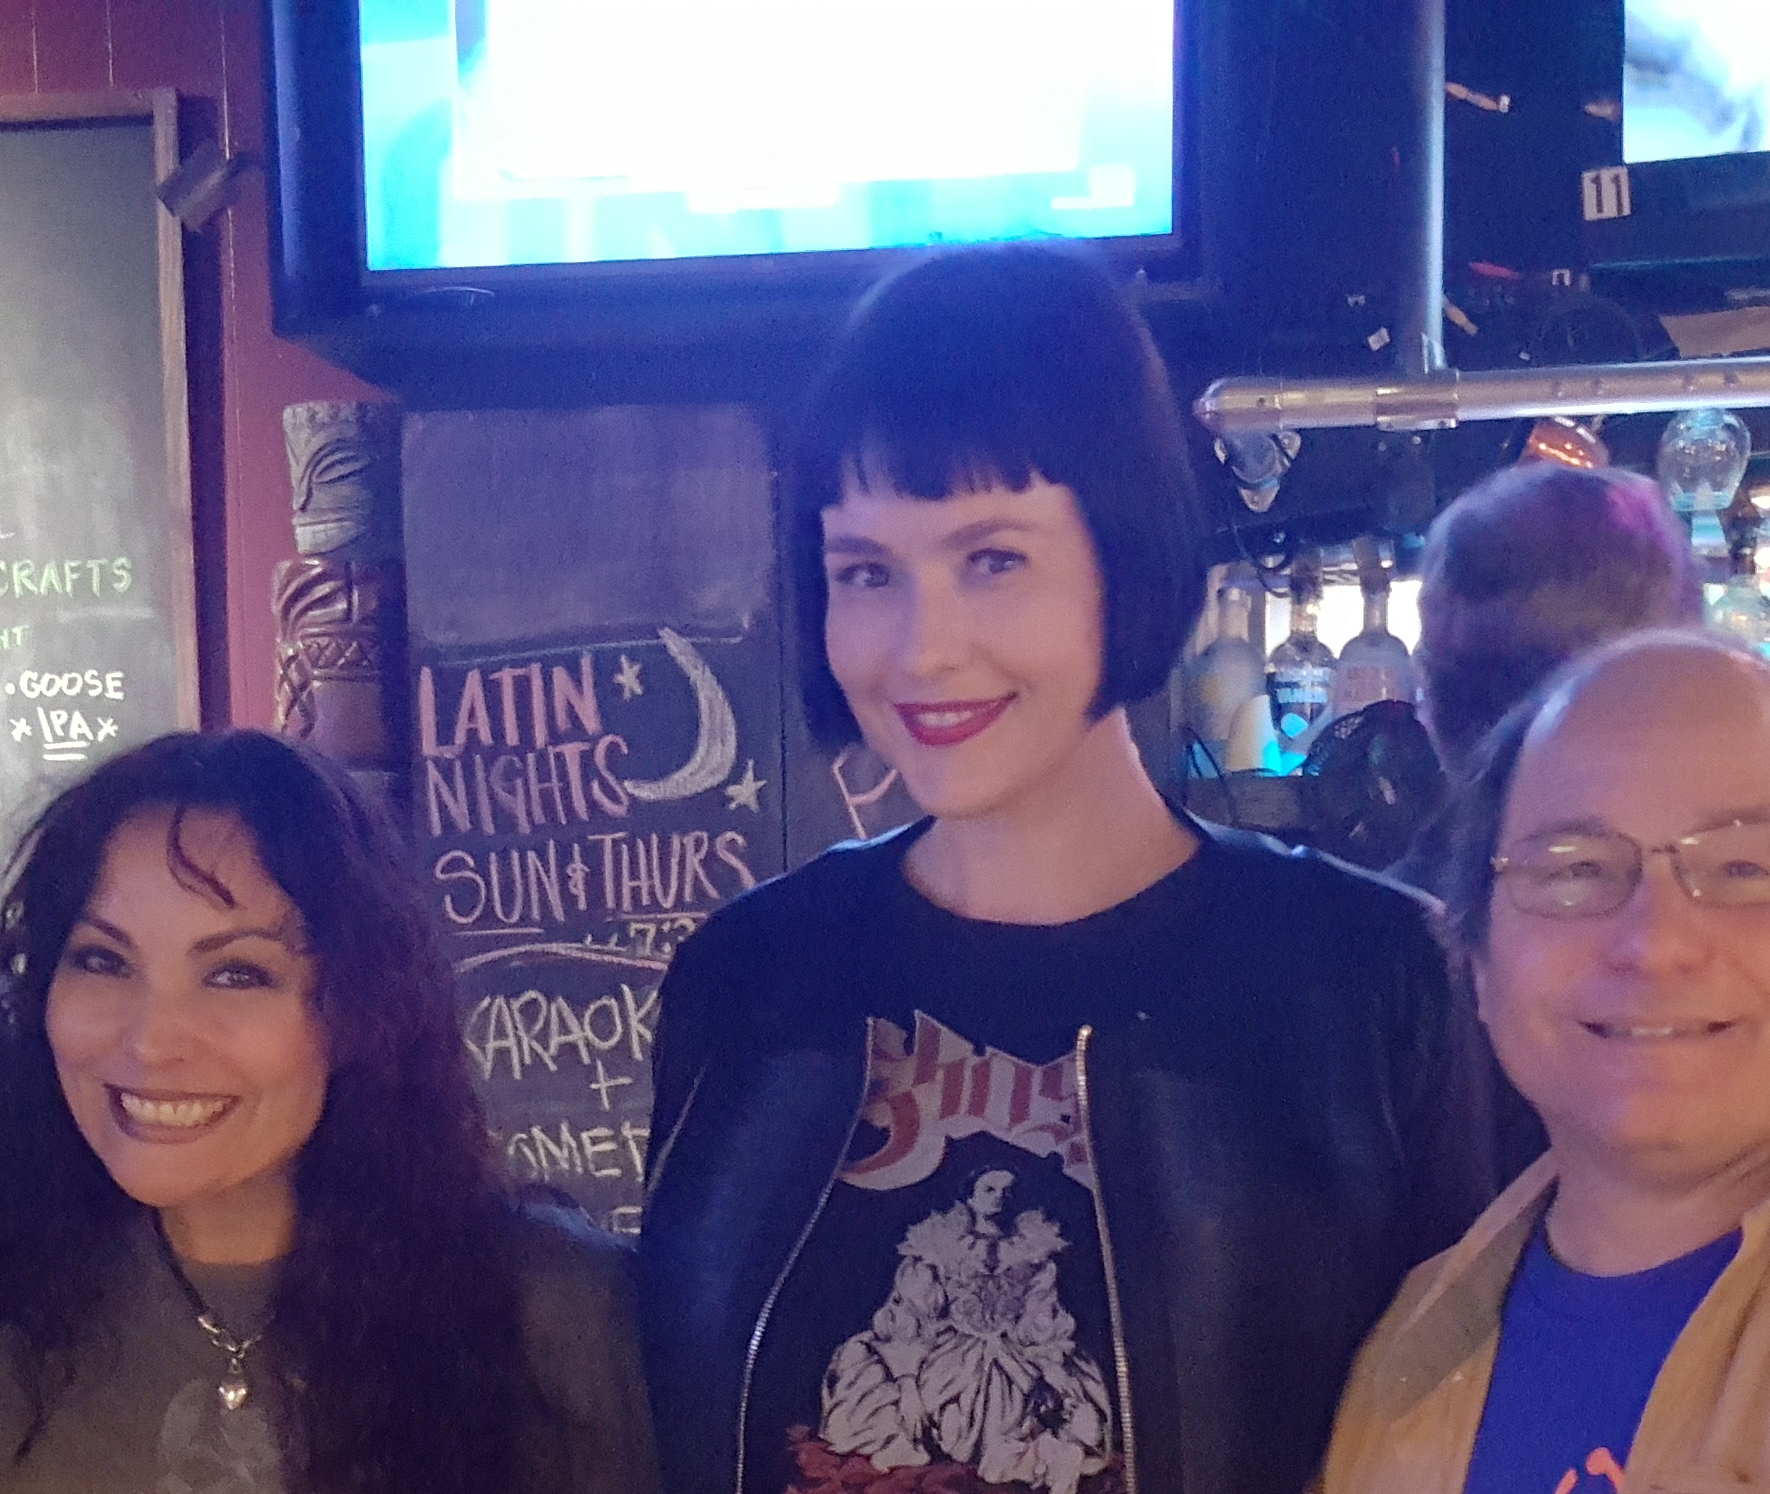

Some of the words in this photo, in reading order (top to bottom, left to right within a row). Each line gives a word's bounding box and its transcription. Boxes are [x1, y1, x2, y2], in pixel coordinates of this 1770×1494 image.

[1591, 173, 1624, 216] 11
[19, 669, 125, 701] GOOSE
[418, 651, 601, 758] LATIN
[36, 705, 94, 743] IPA
[428, 734, 629, 836] NIGHTS
[435, 838, 563, 925] SUN
[586, 831, 755, 912] THURS
